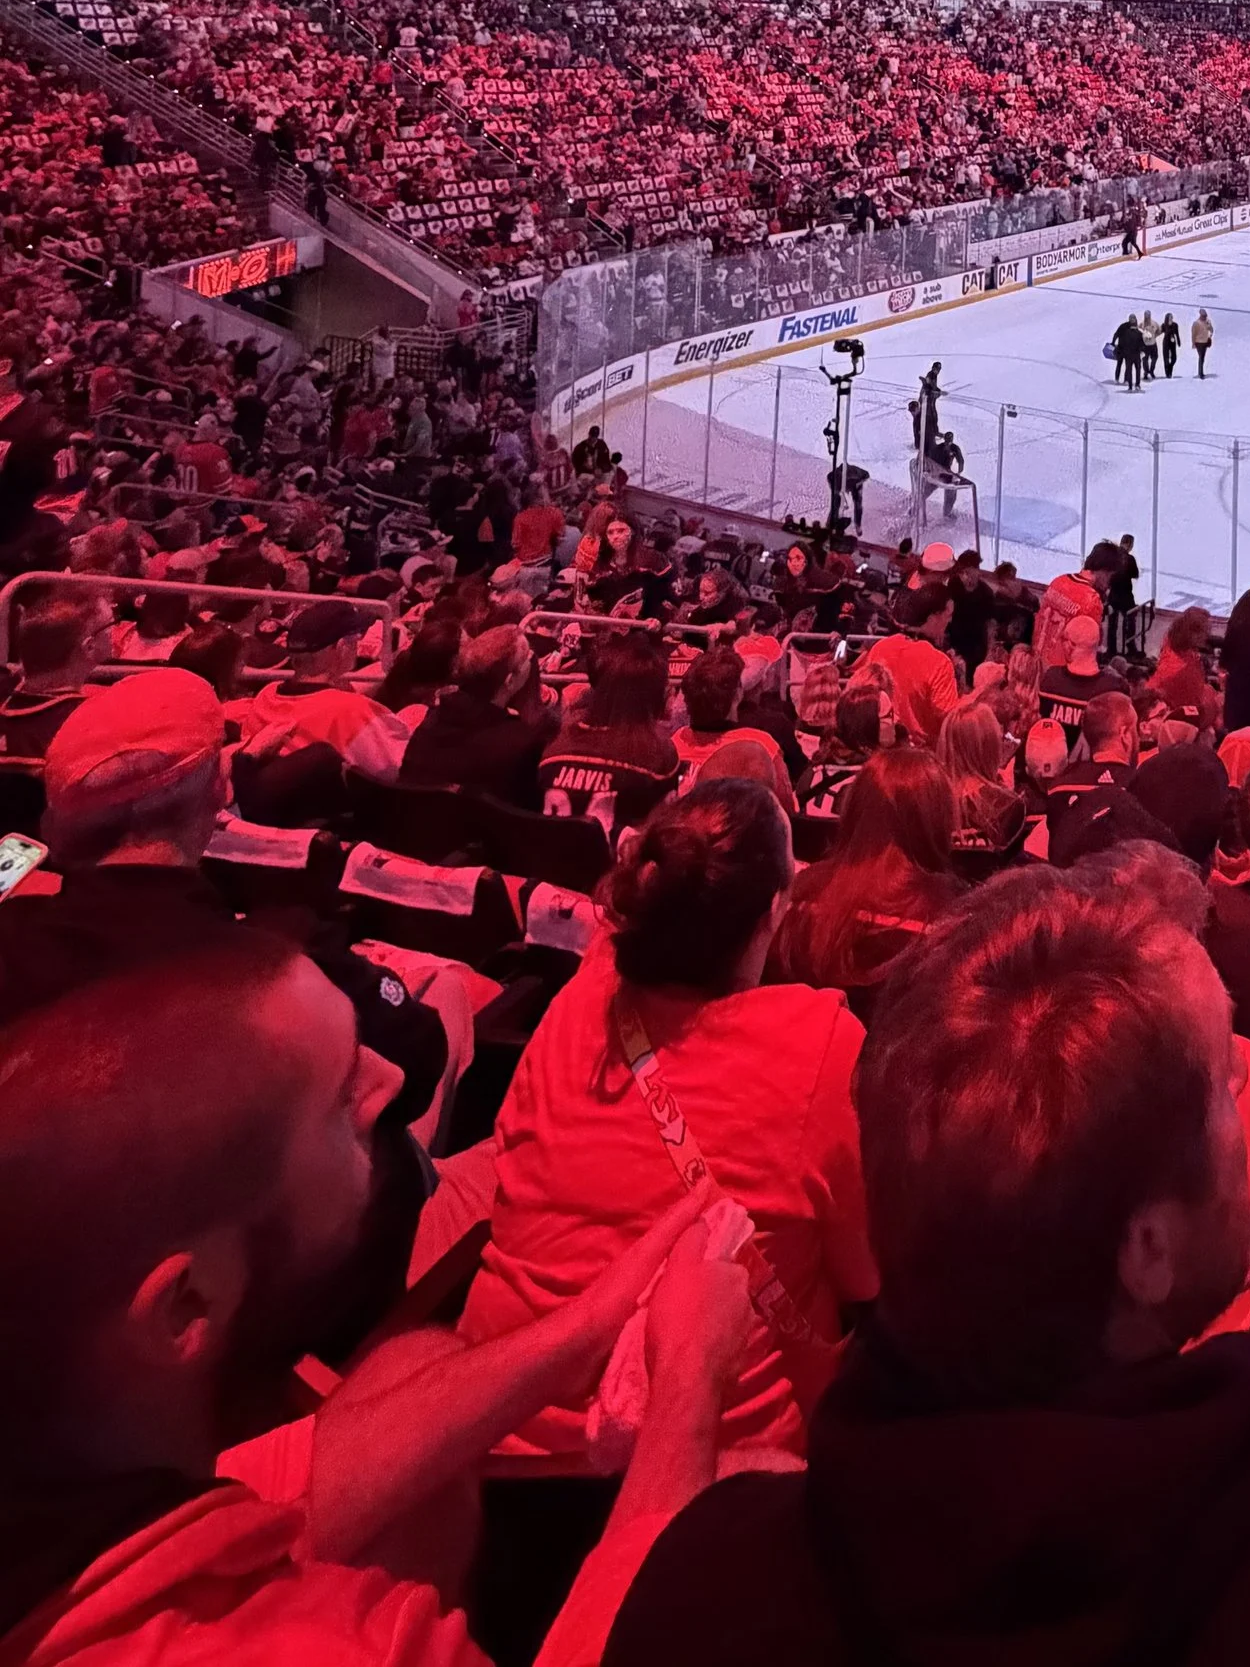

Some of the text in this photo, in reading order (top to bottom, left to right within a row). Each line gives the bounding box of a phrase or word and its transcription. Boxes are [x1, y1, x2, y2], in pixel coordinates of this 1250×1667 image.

[1036, 246, 1087, 269] BODYARMOR
[962, 269, 985, 296] CAT
[999, 262, 1020, 286] CAT
[777, 305, 859, 342] FASTENAL
[674, 328, 753, 366] Energizer
[1051, 703, 1083, 726] JARV
[553, 766, 613, 792] JARVIS
